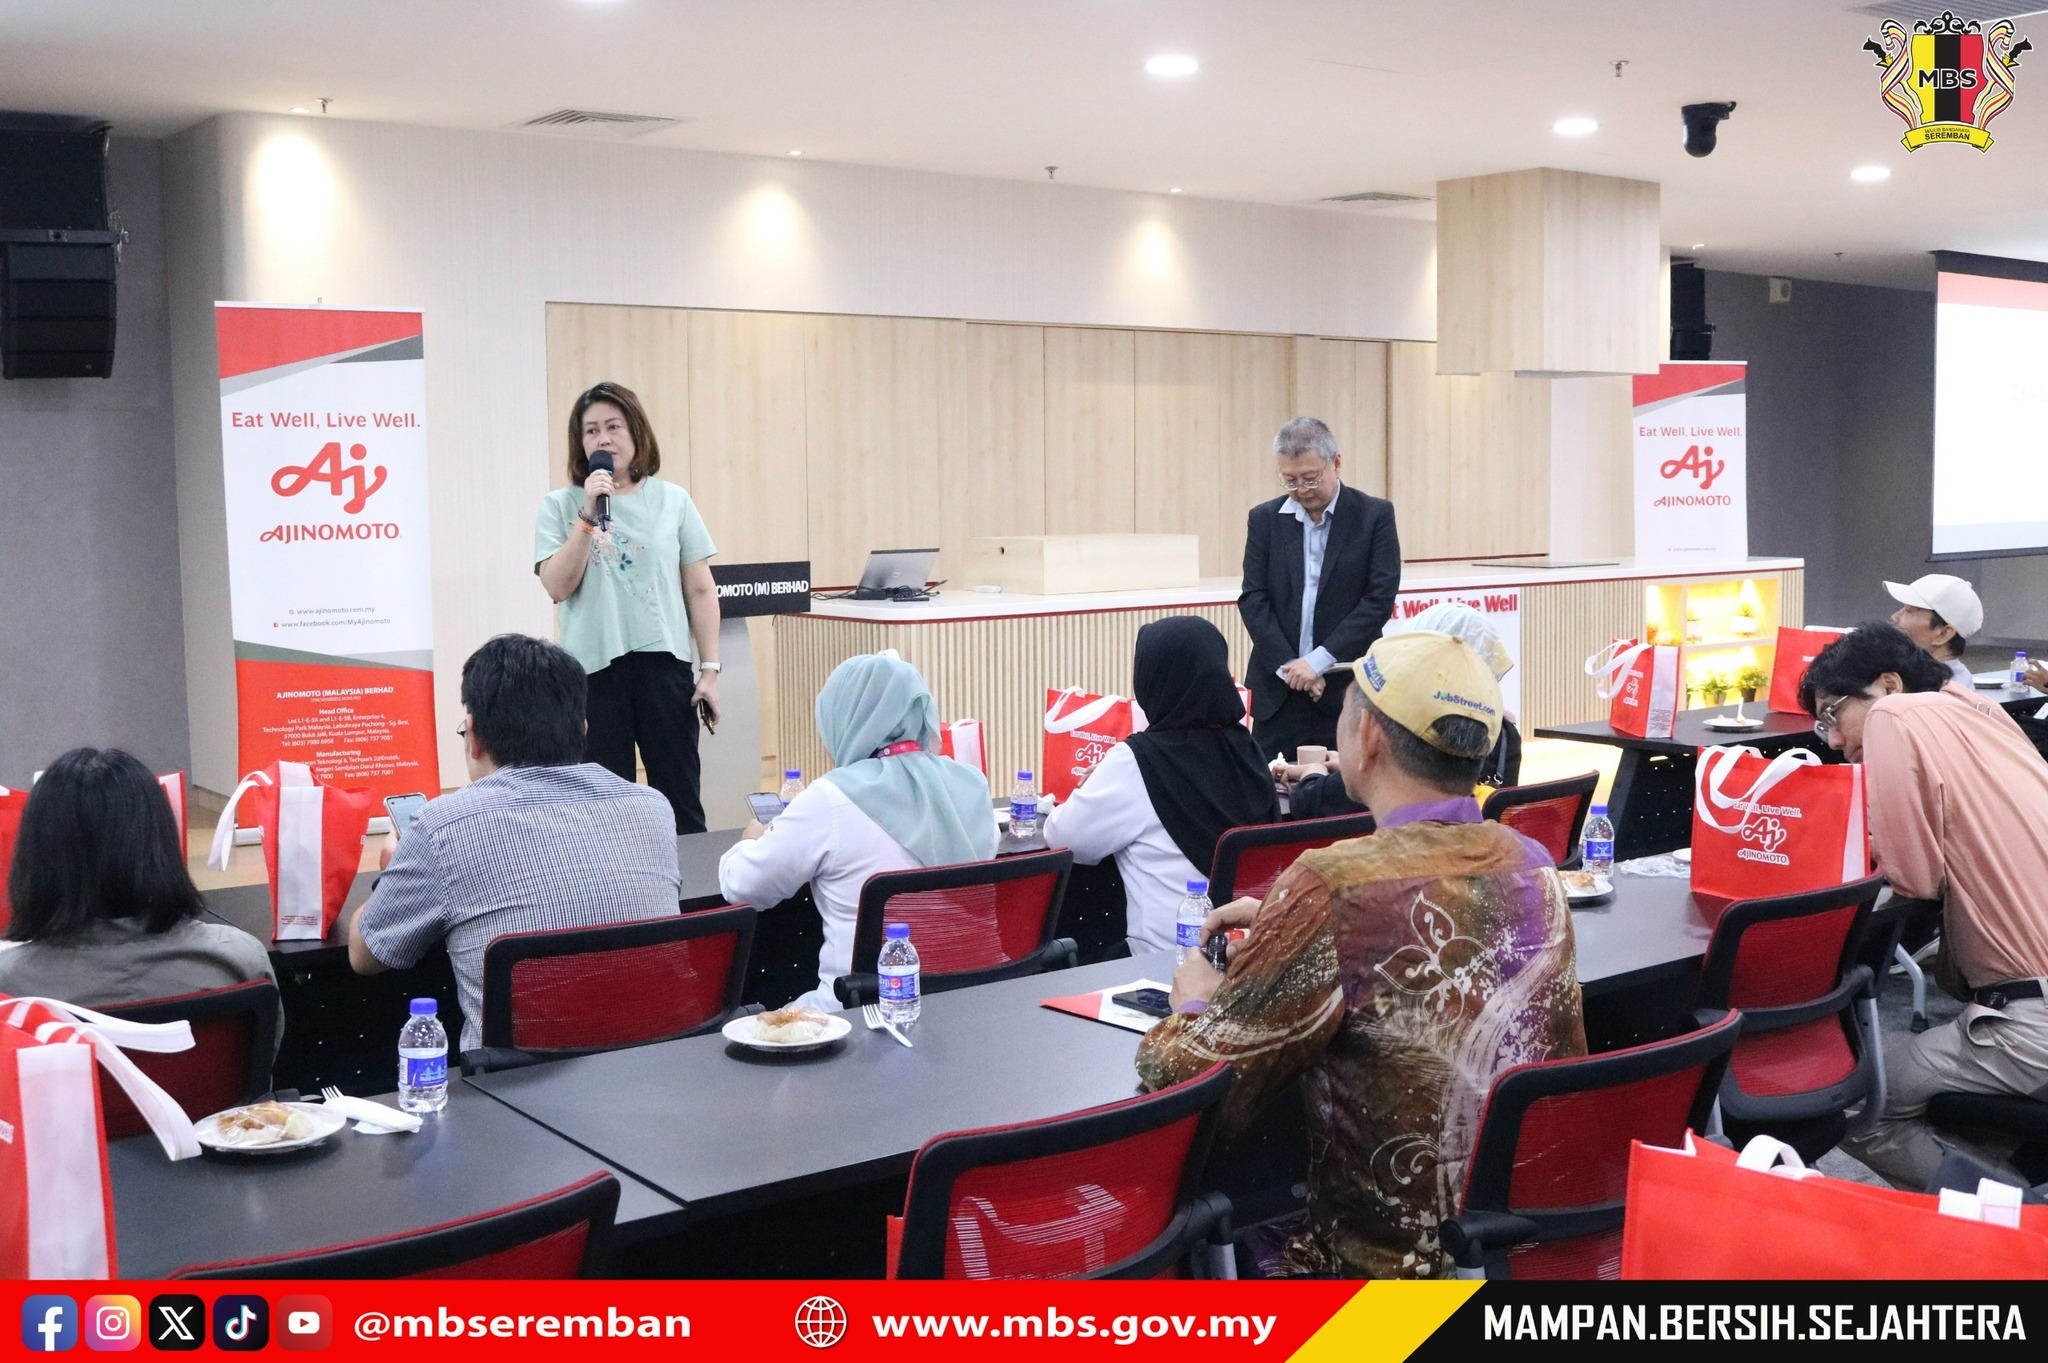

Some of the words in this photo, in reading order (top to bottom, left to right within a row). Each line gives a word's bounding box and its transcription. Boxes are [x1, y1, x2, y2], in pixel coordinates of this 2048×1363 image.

[232, 412, 264, 428] Eat
[270, 412, 320, 429] Well,
[326, 412, 367, 428] Live
[373, 412, 421, 428] Well.
[1639, 426, 1657, 437] Eat
[1691, 427, 1714, 437] Live
[1660, 445, 1725, 490] Aj
[271, 442, 387, 514] Aj
[1653, 495, 1731, 508] AJINOMOTO
[259, 523, 399, 544] AJINOMOTO
[754, 581, 770, 596] (M)
[771, 580, 809, 594] BERHAD
[297, 606, 375, 616] www.ajinomoto.com.my
[1483, 594, 1518, 613] Well
[277, 690, 321, 699] AJINOMOTO
[322, 688, 363, 697] (MALAYSIA)
[364, 686, 394, 695] BERHAD
[332, 722, 361, 730] Lebuhraya
[316, 749, 361, 758] Manufacturing
[1762, 804, 1780, 815] Live
[1742, 817, 1787, 852] Aj
[1738, 849, 1788, 865] AJINOMOTO
